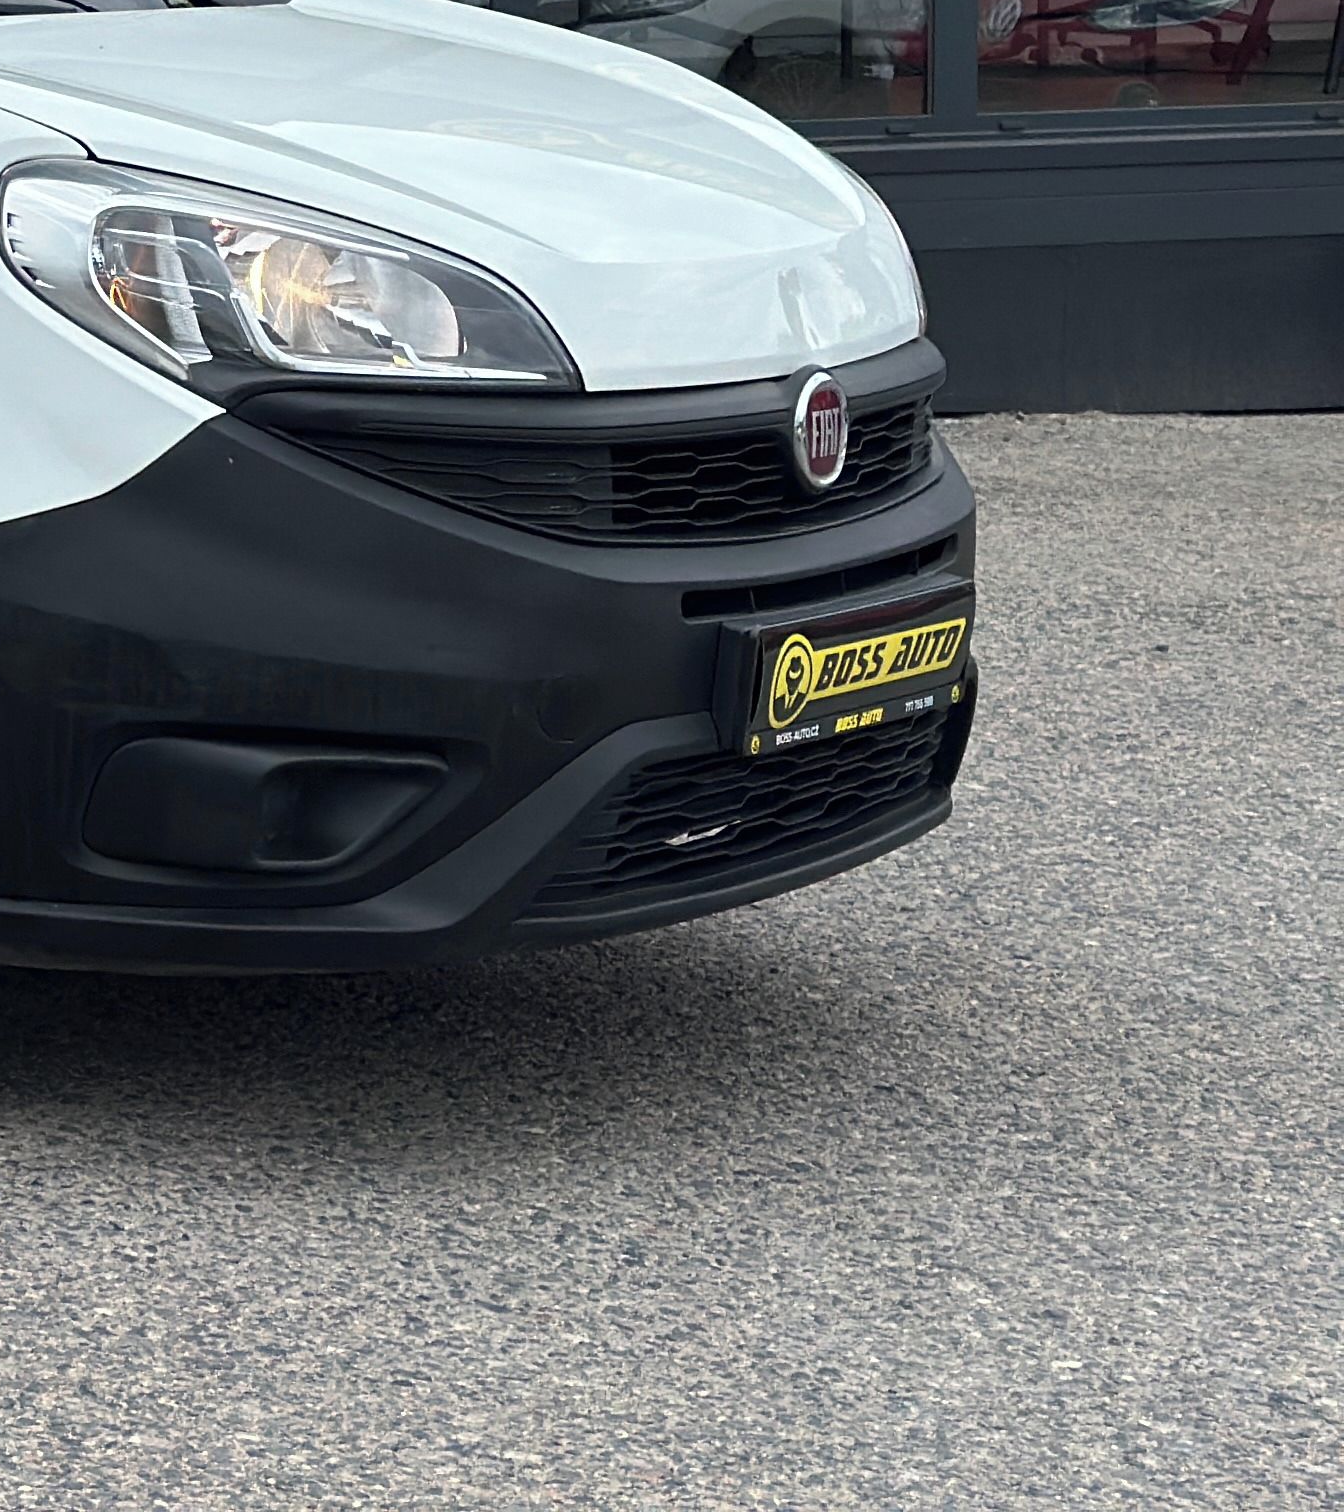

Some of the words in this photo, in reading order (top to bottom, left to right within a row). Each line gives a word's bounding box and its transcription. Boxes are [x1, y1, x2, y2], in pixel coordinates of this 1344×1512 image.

[811, 407, 840, 459] FIAT
[815, 642, 887, 692] BOSS
[888, 625, 961, 675] AUTO
[834, 713, 859, 733] BOSS
[859, 707, 885, 727] AUTO
